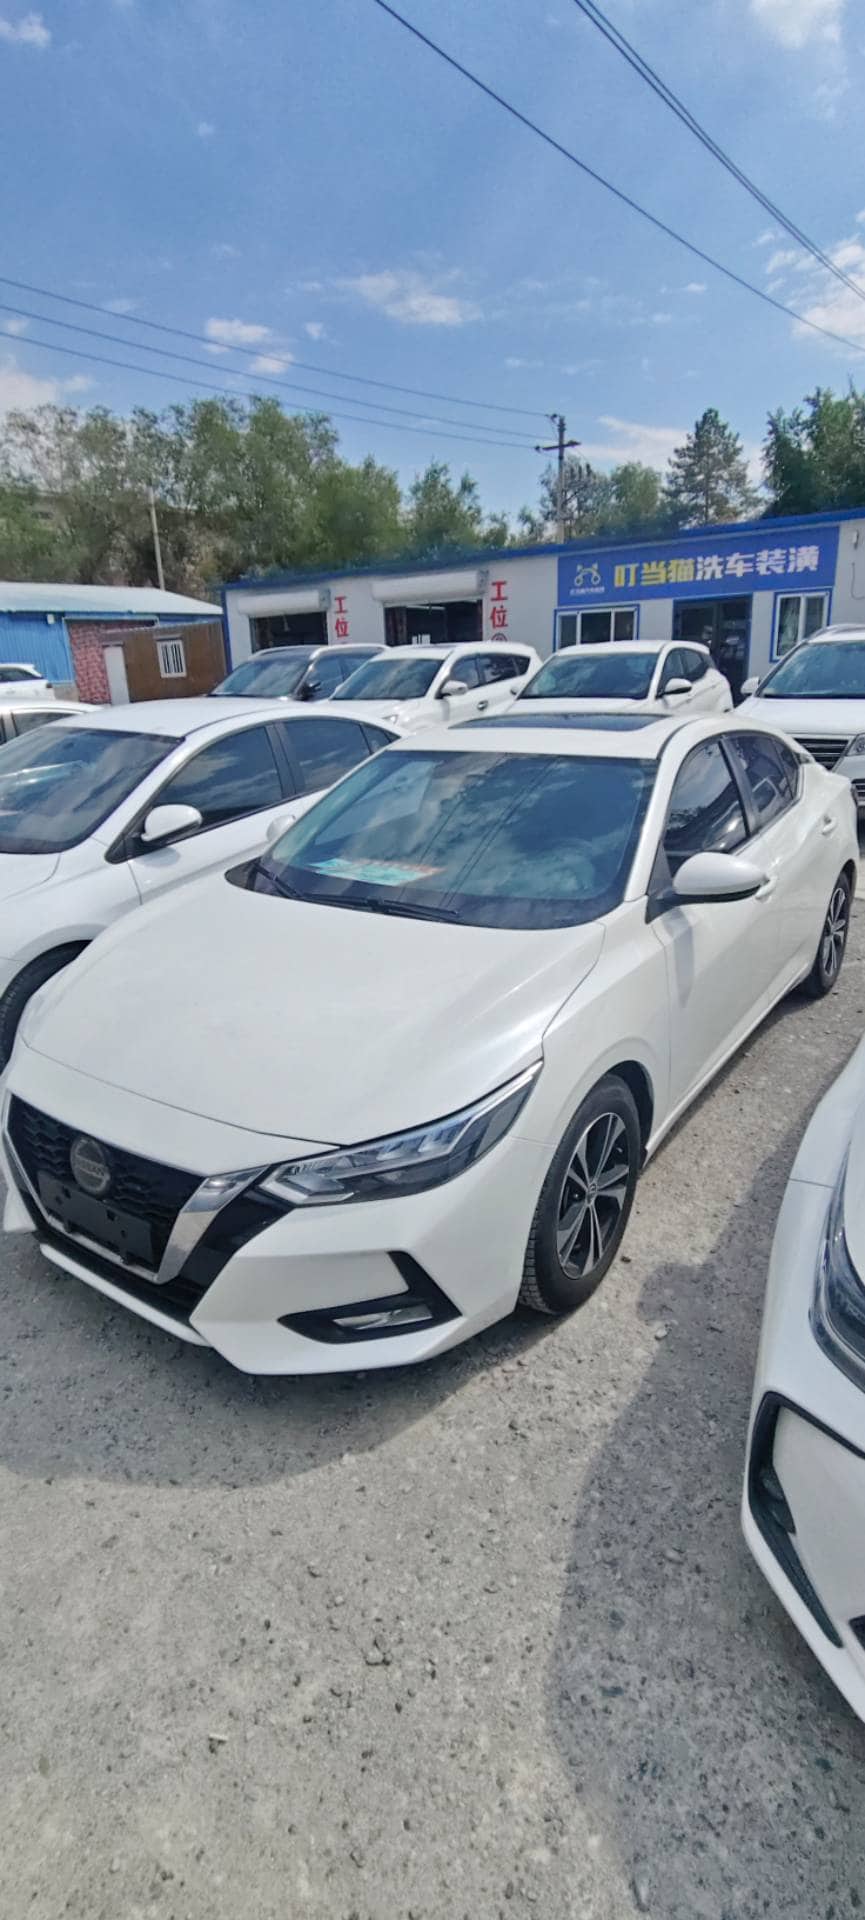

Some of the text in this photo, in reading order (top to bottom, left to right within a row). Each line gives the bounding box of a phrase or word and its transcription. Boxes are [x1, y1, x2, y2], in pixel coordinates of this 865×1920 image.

[613, 545, 820, 588] 叮当猫洗车装潢
[334, 596, 349, 638] 工位
